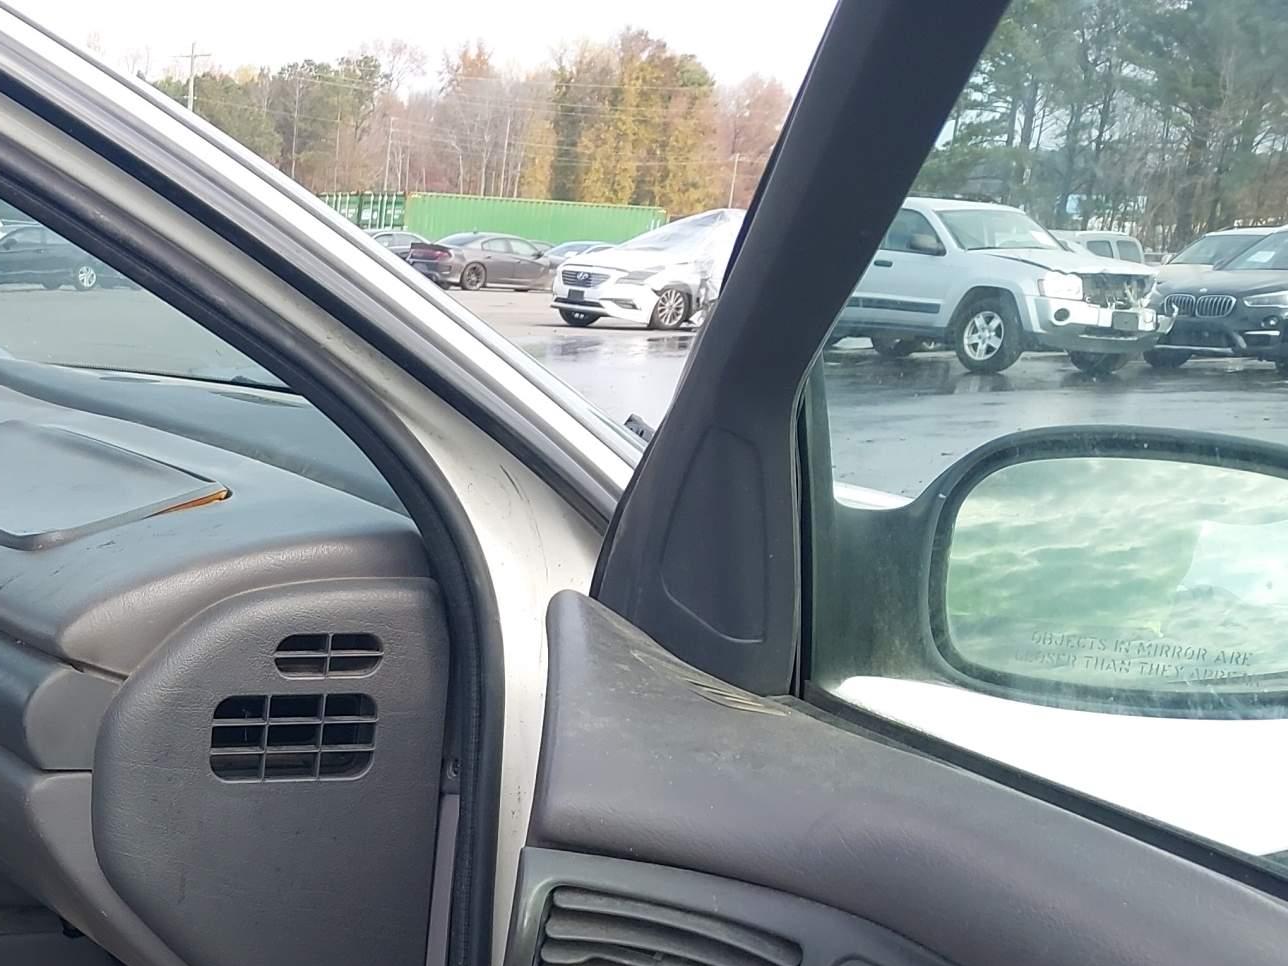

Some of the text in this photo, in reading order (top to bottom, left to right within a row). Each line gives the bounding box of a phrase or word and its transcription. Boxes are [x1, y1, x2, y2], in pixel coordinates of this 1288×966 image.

[1031, 631, 1253, 666] OBJECTS IN MIRROR ARE
[1083, 655, 1131, 673] THAN
[1139, 661, 1184, 678] THEY
